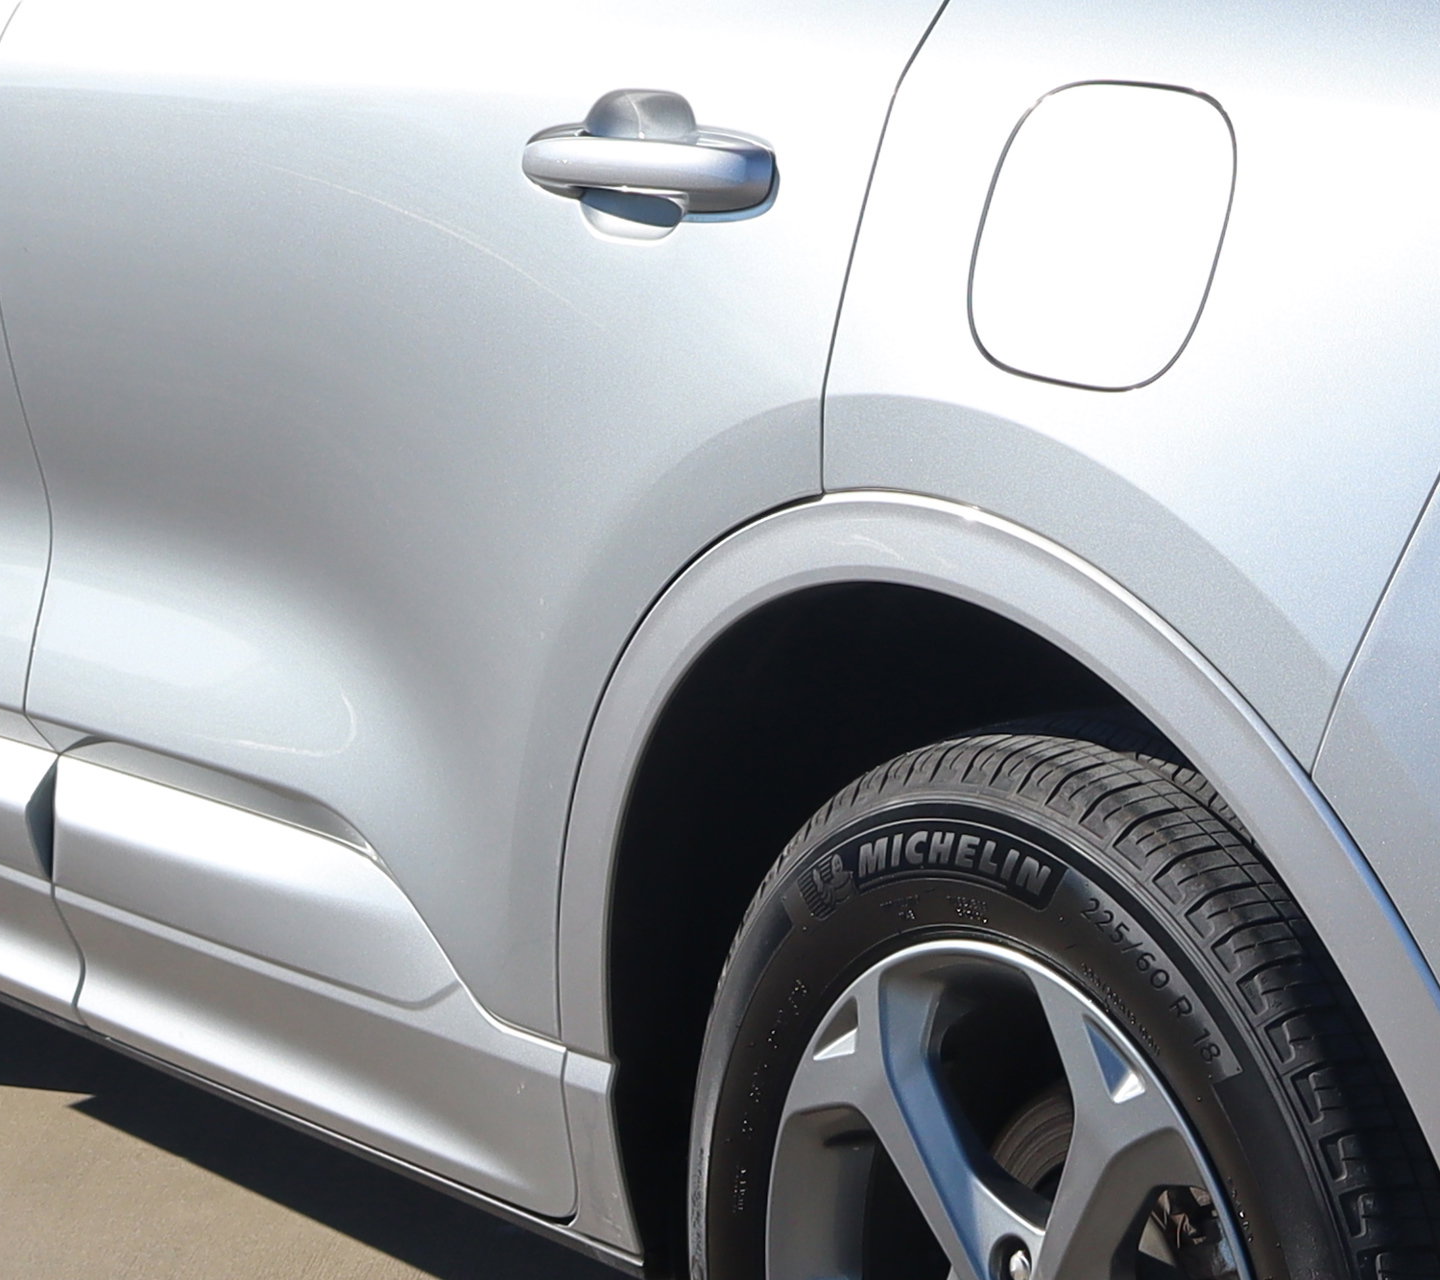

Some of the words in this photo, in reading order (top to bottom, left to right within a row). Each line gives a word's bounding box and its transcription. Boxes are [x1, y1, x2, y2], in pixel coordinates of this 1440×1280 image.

[859, 831, 1051, 898] MICHELIN
[1081, 897, 1170, 991] 225/60
[1168, 995, 1194, 1021] R
[1192, 1031, 1222, 1063] 18
